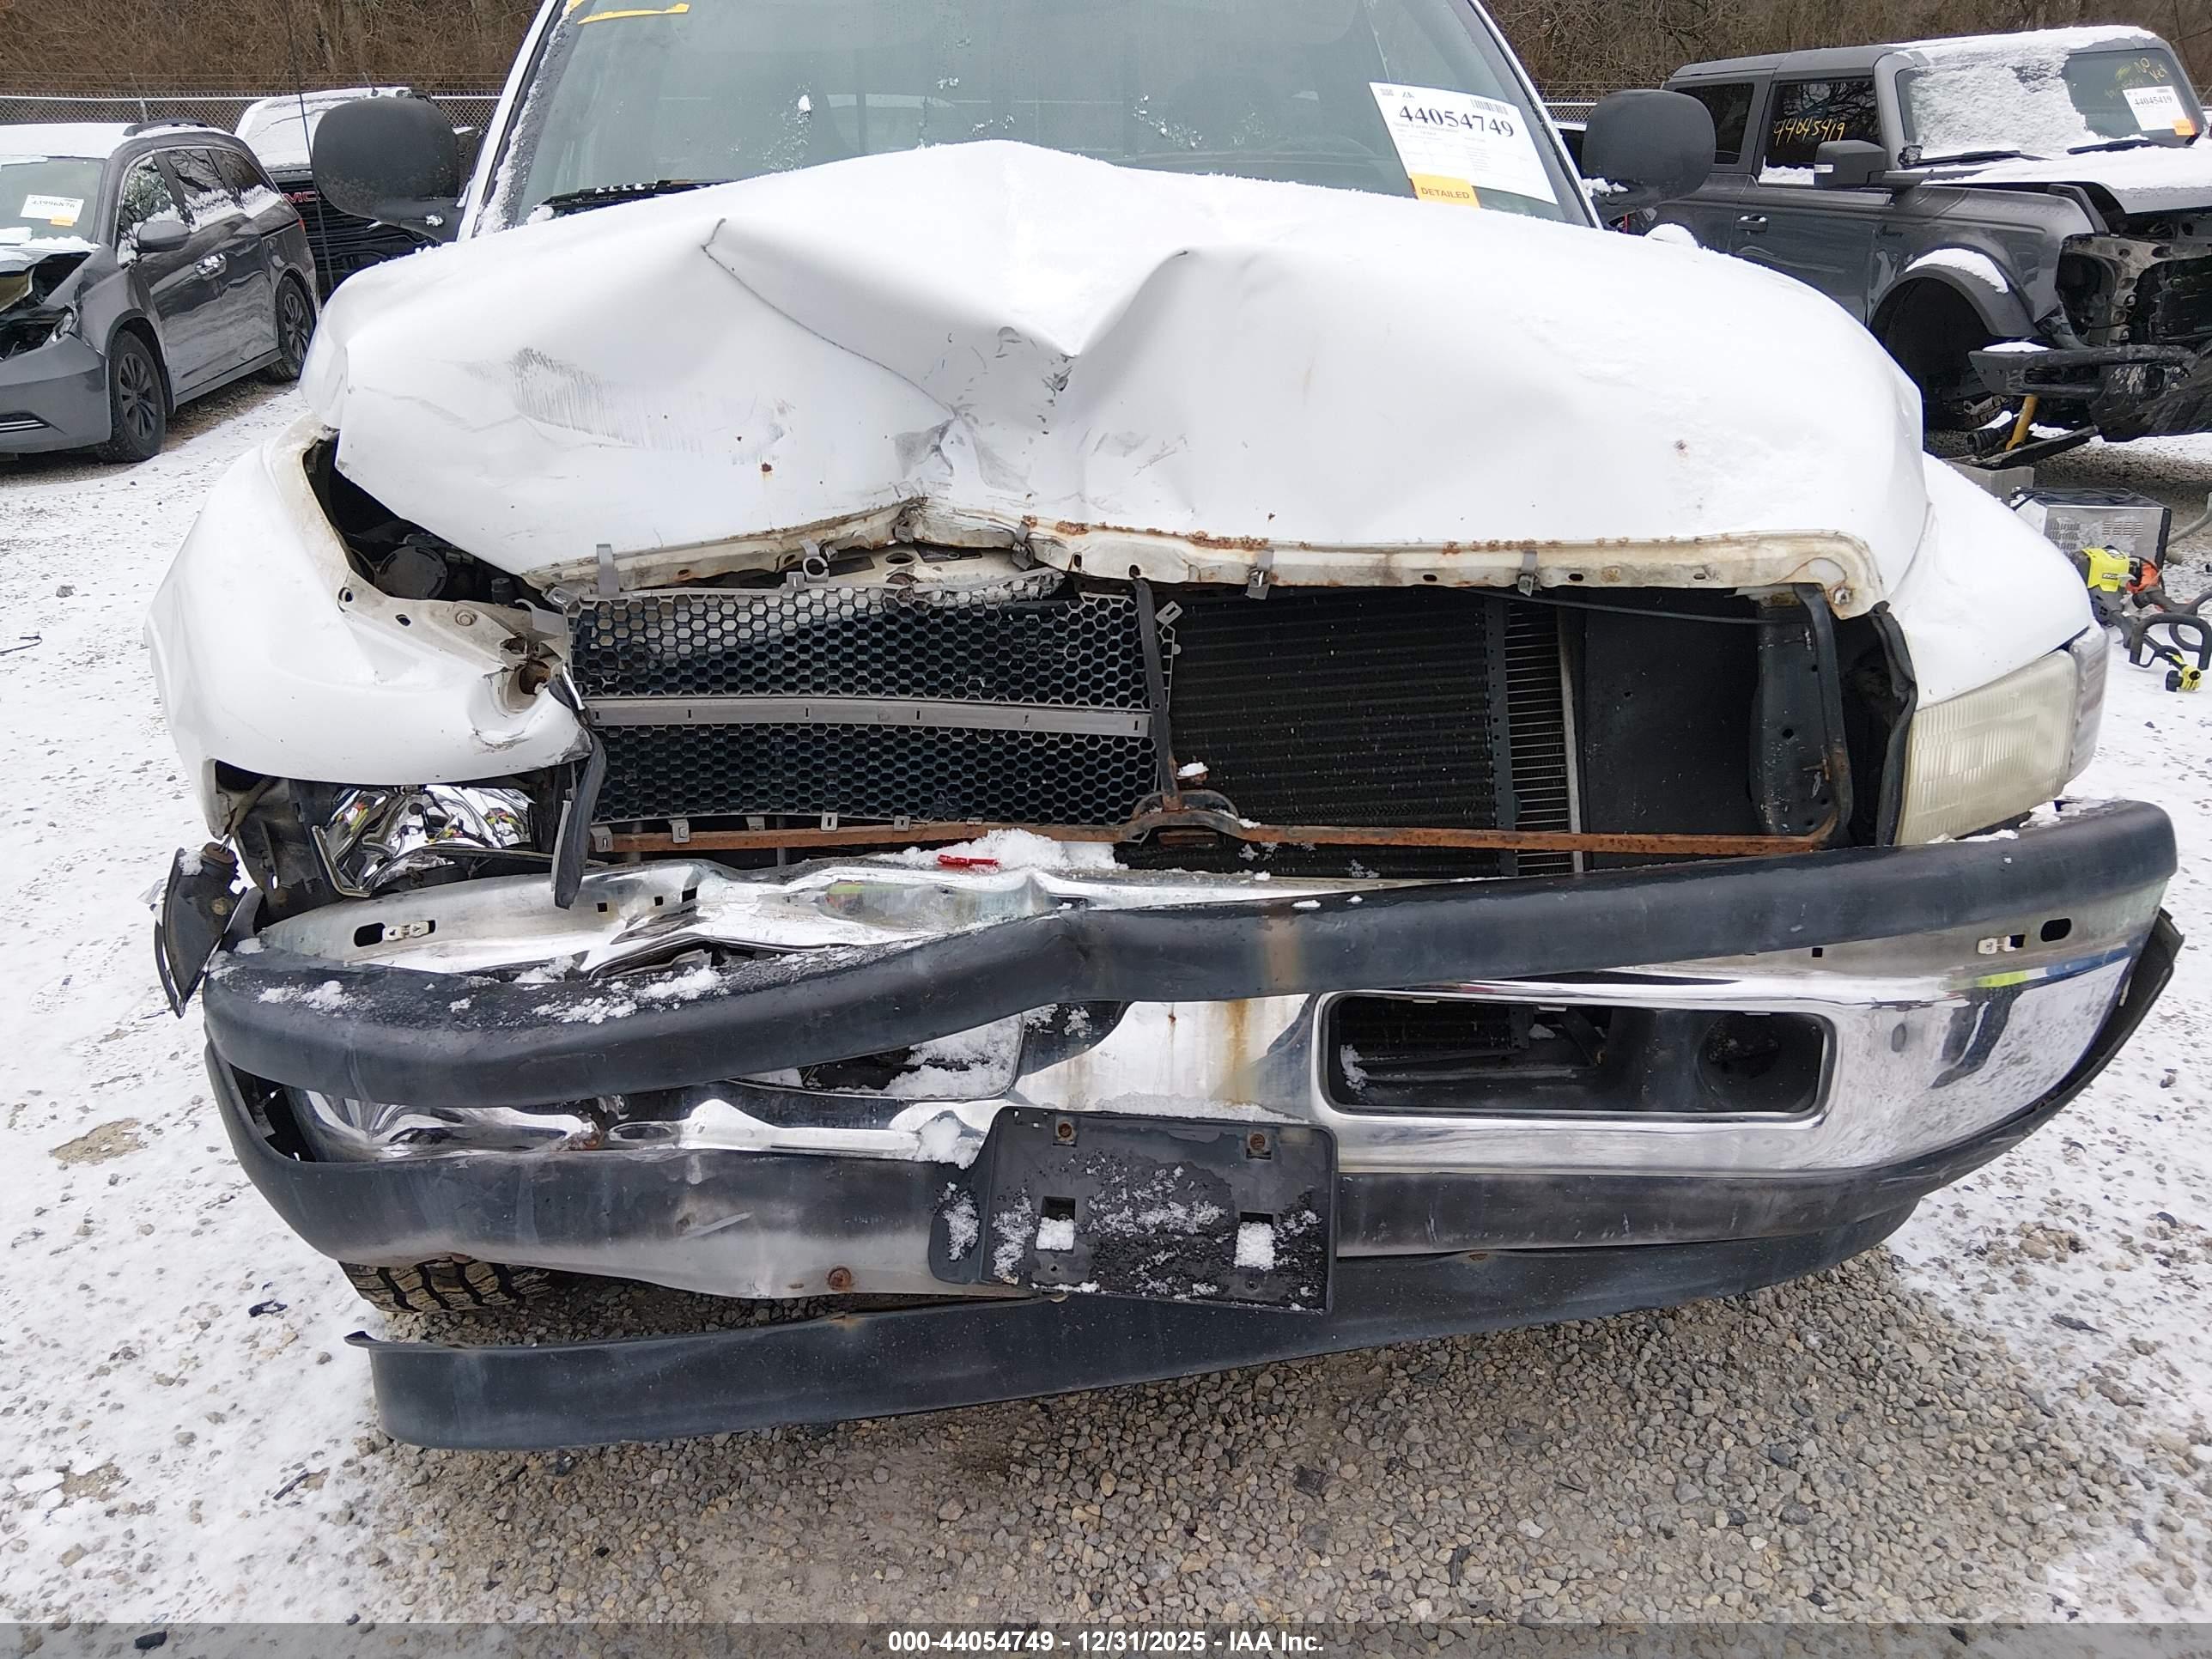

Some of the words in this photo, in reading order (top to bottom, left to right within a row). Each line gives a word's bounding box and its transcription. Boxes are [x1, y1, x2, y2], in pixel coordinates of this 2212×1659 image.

[1399, 105, 1514, 137] 44054749
[1773, 117, 1845, 147] 44045419
[1420, 186, 1470, 199] DETAILED
